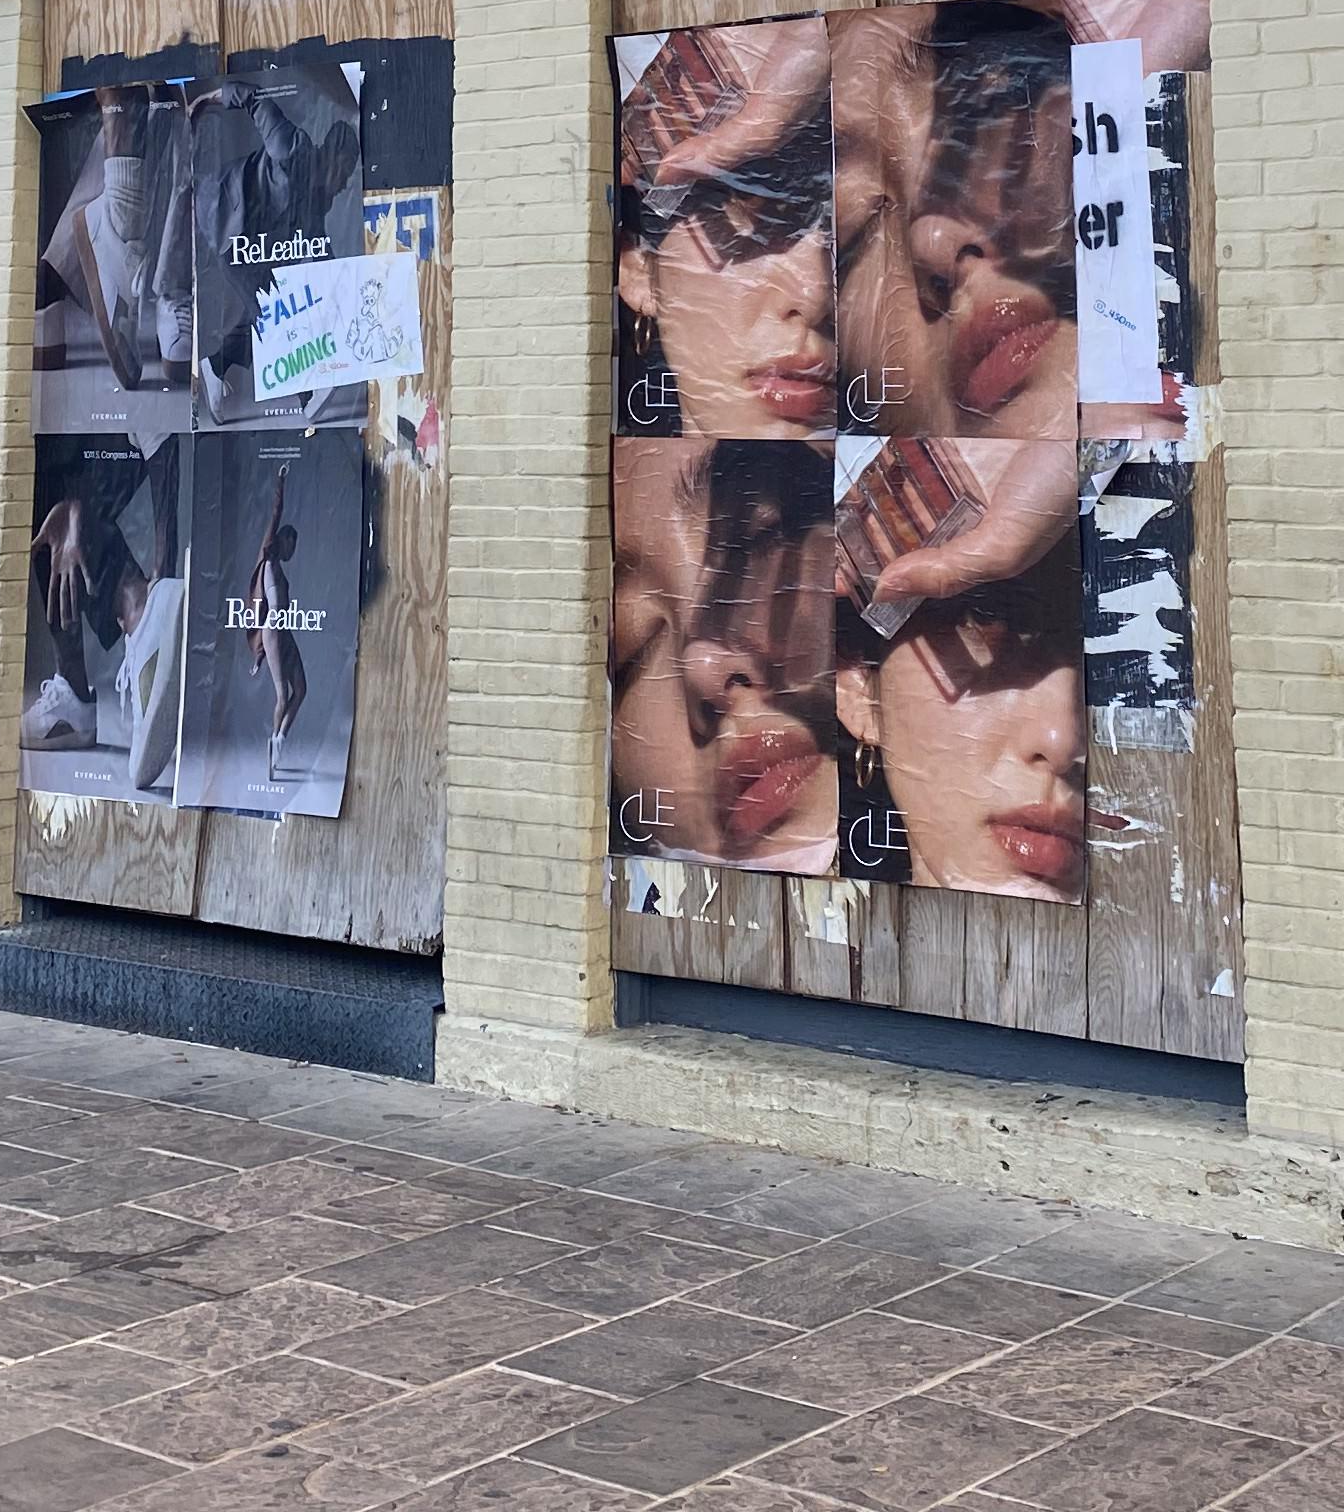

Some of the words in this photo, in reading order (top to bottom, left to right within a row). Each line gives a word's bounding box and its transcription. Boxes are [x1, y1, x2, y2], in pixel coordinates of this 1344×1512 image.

[229, 230, 331, 266] ReLeather
[257, 284, 323, 334] FALL
[263, 331, 337, 390] COMING
[264, 408, 304, 416] EVERLANE
[224, 598, 327, 632] ReLeather
[247, 784, 285, 794] EVERLANE
